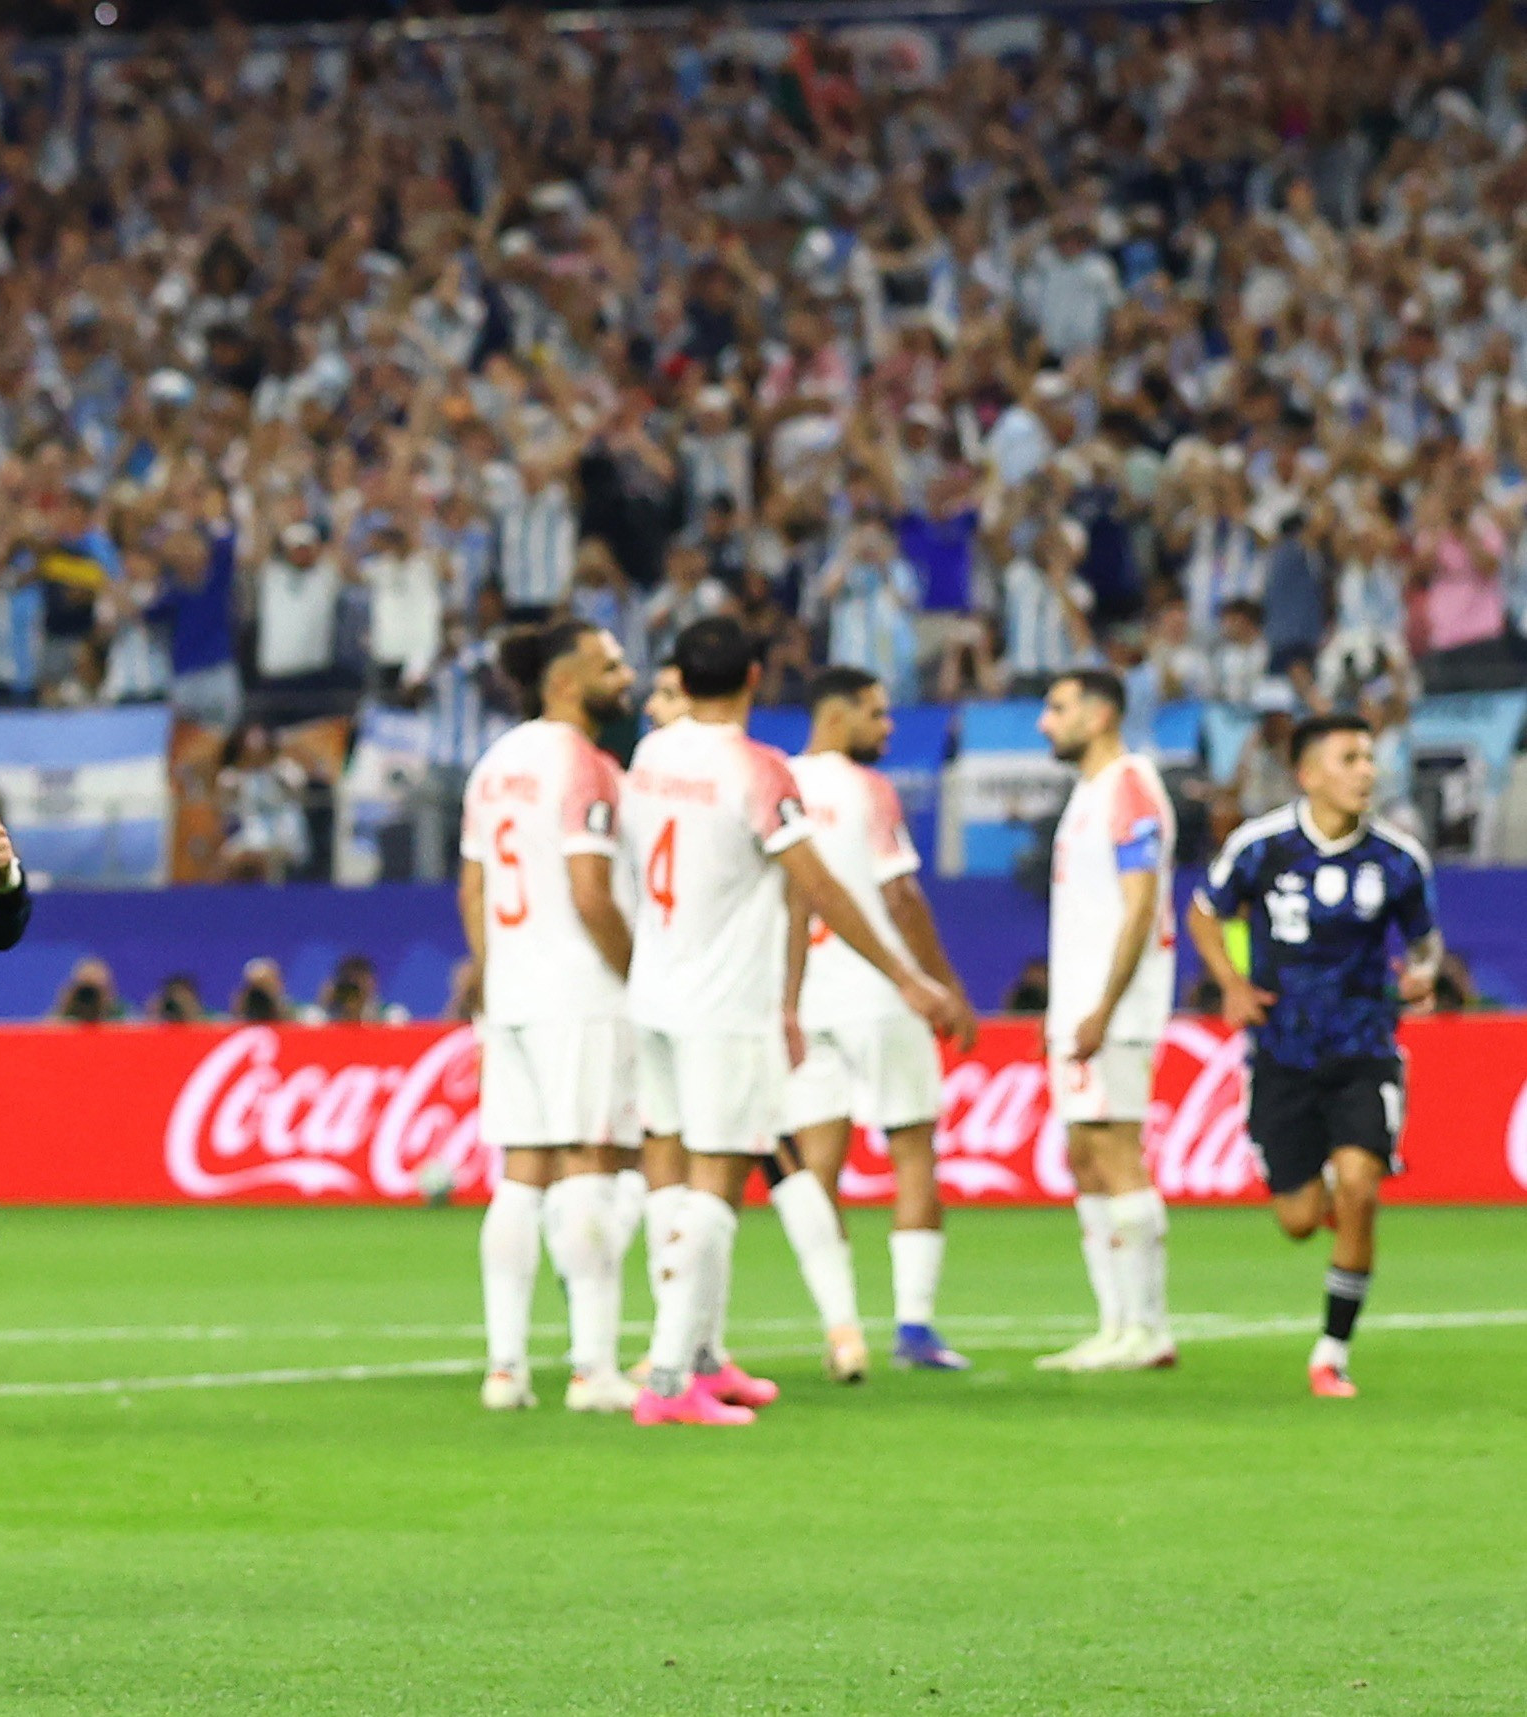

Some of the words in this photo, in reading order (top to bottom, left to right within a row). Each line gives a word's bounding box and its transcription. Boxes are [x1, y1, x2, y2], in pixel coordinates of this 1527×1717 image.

[494, 816, 528, 926] 5
[646, 816, 677, 925] 4
[164, 1025, 507, 1198] Coca-Co
